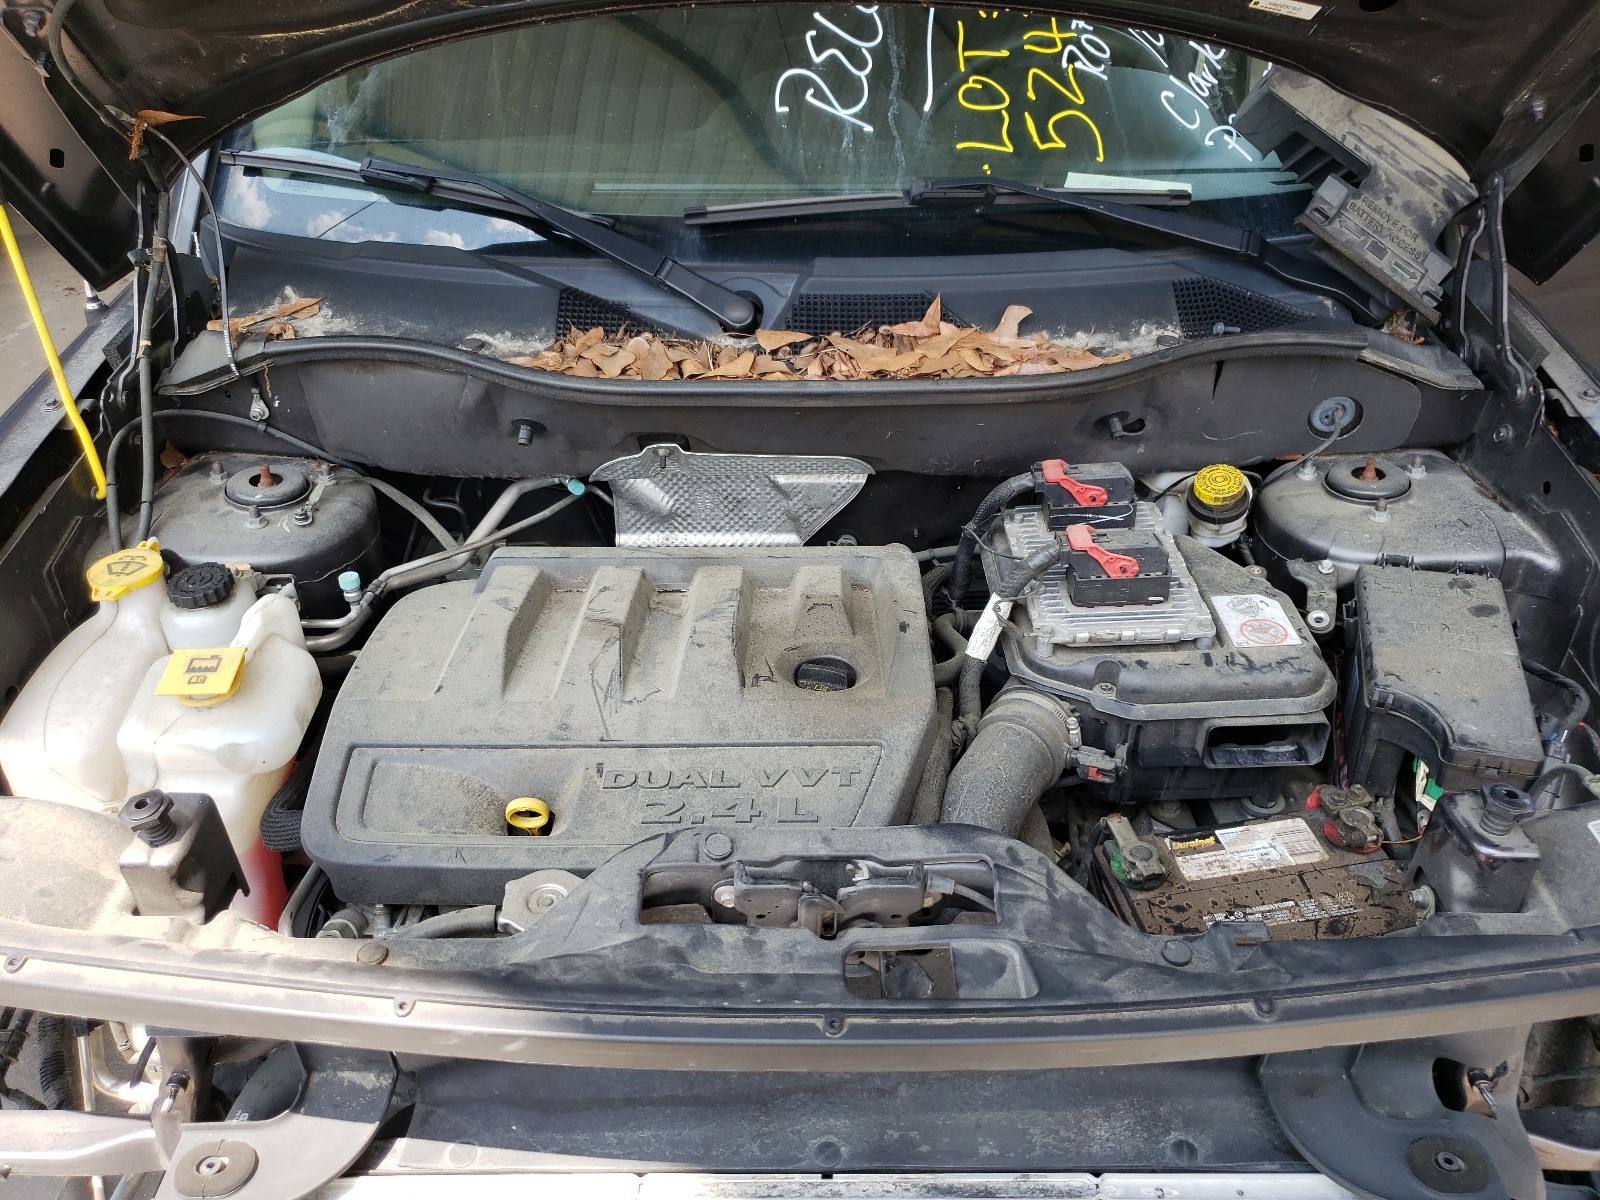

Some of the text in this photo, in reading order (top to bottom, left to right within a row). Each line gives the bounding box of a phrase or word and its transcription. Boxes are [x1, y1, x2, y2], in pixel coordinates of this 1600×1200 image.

[1023, 17, 1104, 162] 524
[1348, 201, 1422, 259] BATTERY ACCESS
[1362, 195, 1418, 242] REMOVE FOR
[602, 768, 861, 789] DUAL VVT
[641, 798, 819, 824] 2.4L
